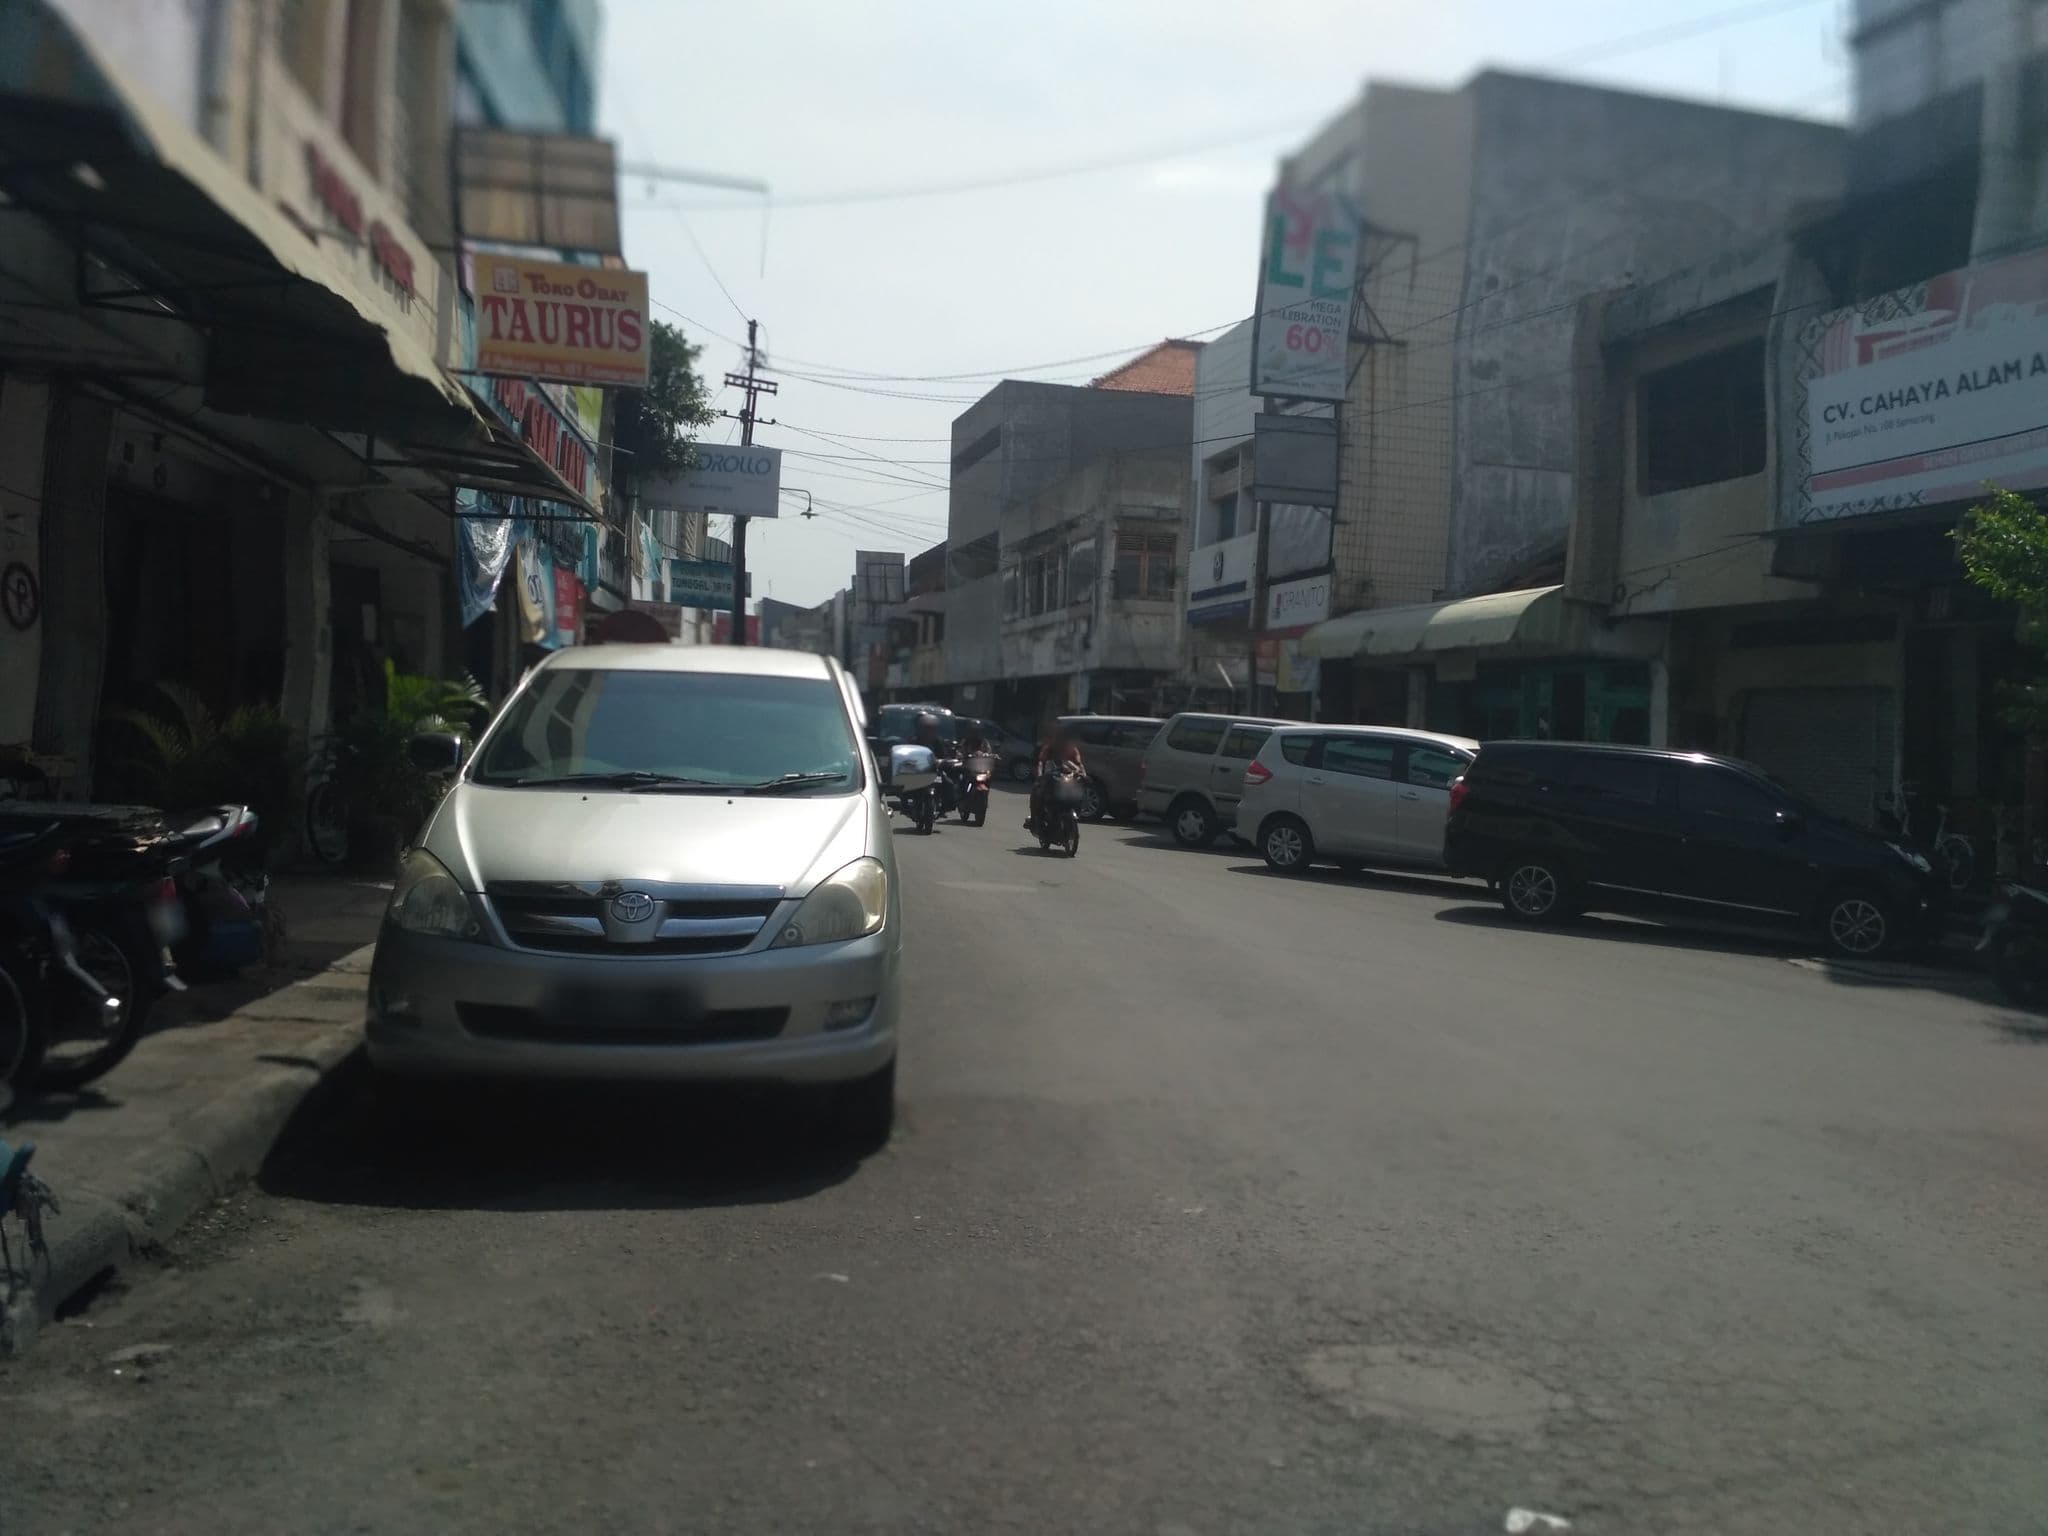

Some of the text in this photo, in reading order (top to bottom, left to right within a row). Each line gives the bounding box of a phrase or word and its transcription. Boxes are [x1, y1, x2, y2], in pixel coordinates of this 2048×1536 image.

[481, 295, 642, 353] TAURUS
[1311, 302, 1341, 314] MEGA
[1823, 401, 1855, 424] CV.
[1860, 378, 1950, 416] CAHAYA
[1956, 358, 2022, 395] ALAM
[1281, 584, 1326, 609] GRANITO
